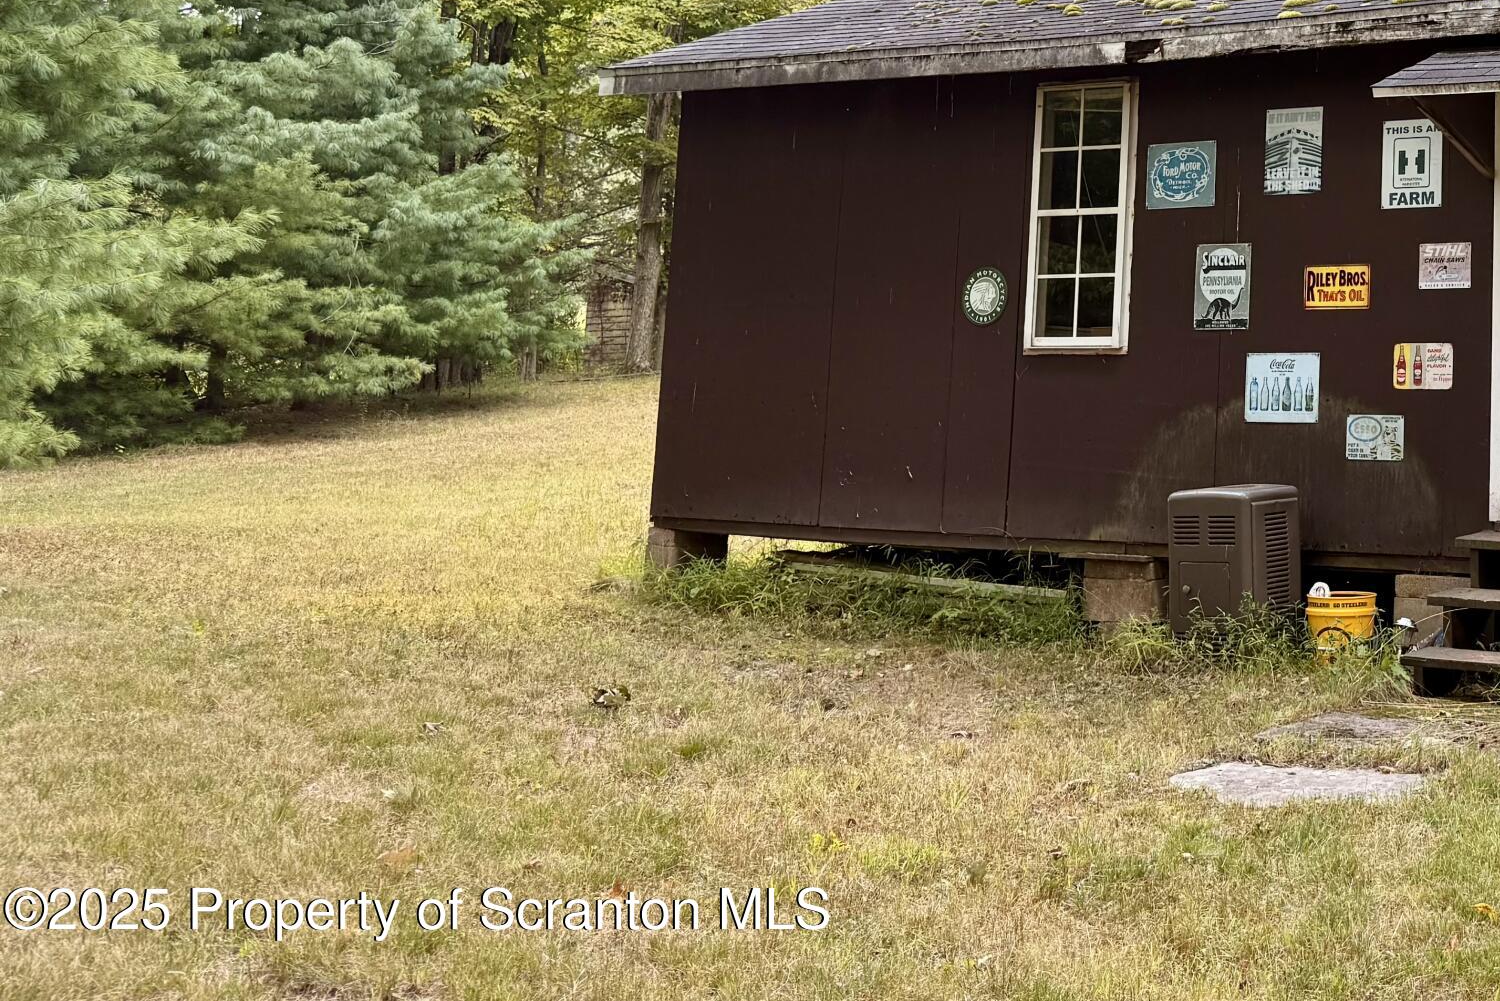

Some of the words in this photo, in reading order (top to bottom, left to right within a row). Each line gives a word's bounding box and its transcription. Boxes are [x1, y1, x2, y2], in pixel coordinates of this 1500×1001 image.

[1386, 126, 1410, 135] THIS
[1412, 125, 1423, 133] IS
[1389, 190, 1435, 206] FARM
[1424, 245, 1466, 257] STIHL
[1202, 251, 1245, 270] SINCLAIR
[1424, 256, 1446, 264] CHAIN
[1202, 275, 1242, 287] PENNSYLVANIA
[1306, 270, 1338, 302] RILEY
[1338, 269, 1369, 287] BROS.
[1348, 288, 1365, 302] OIL
